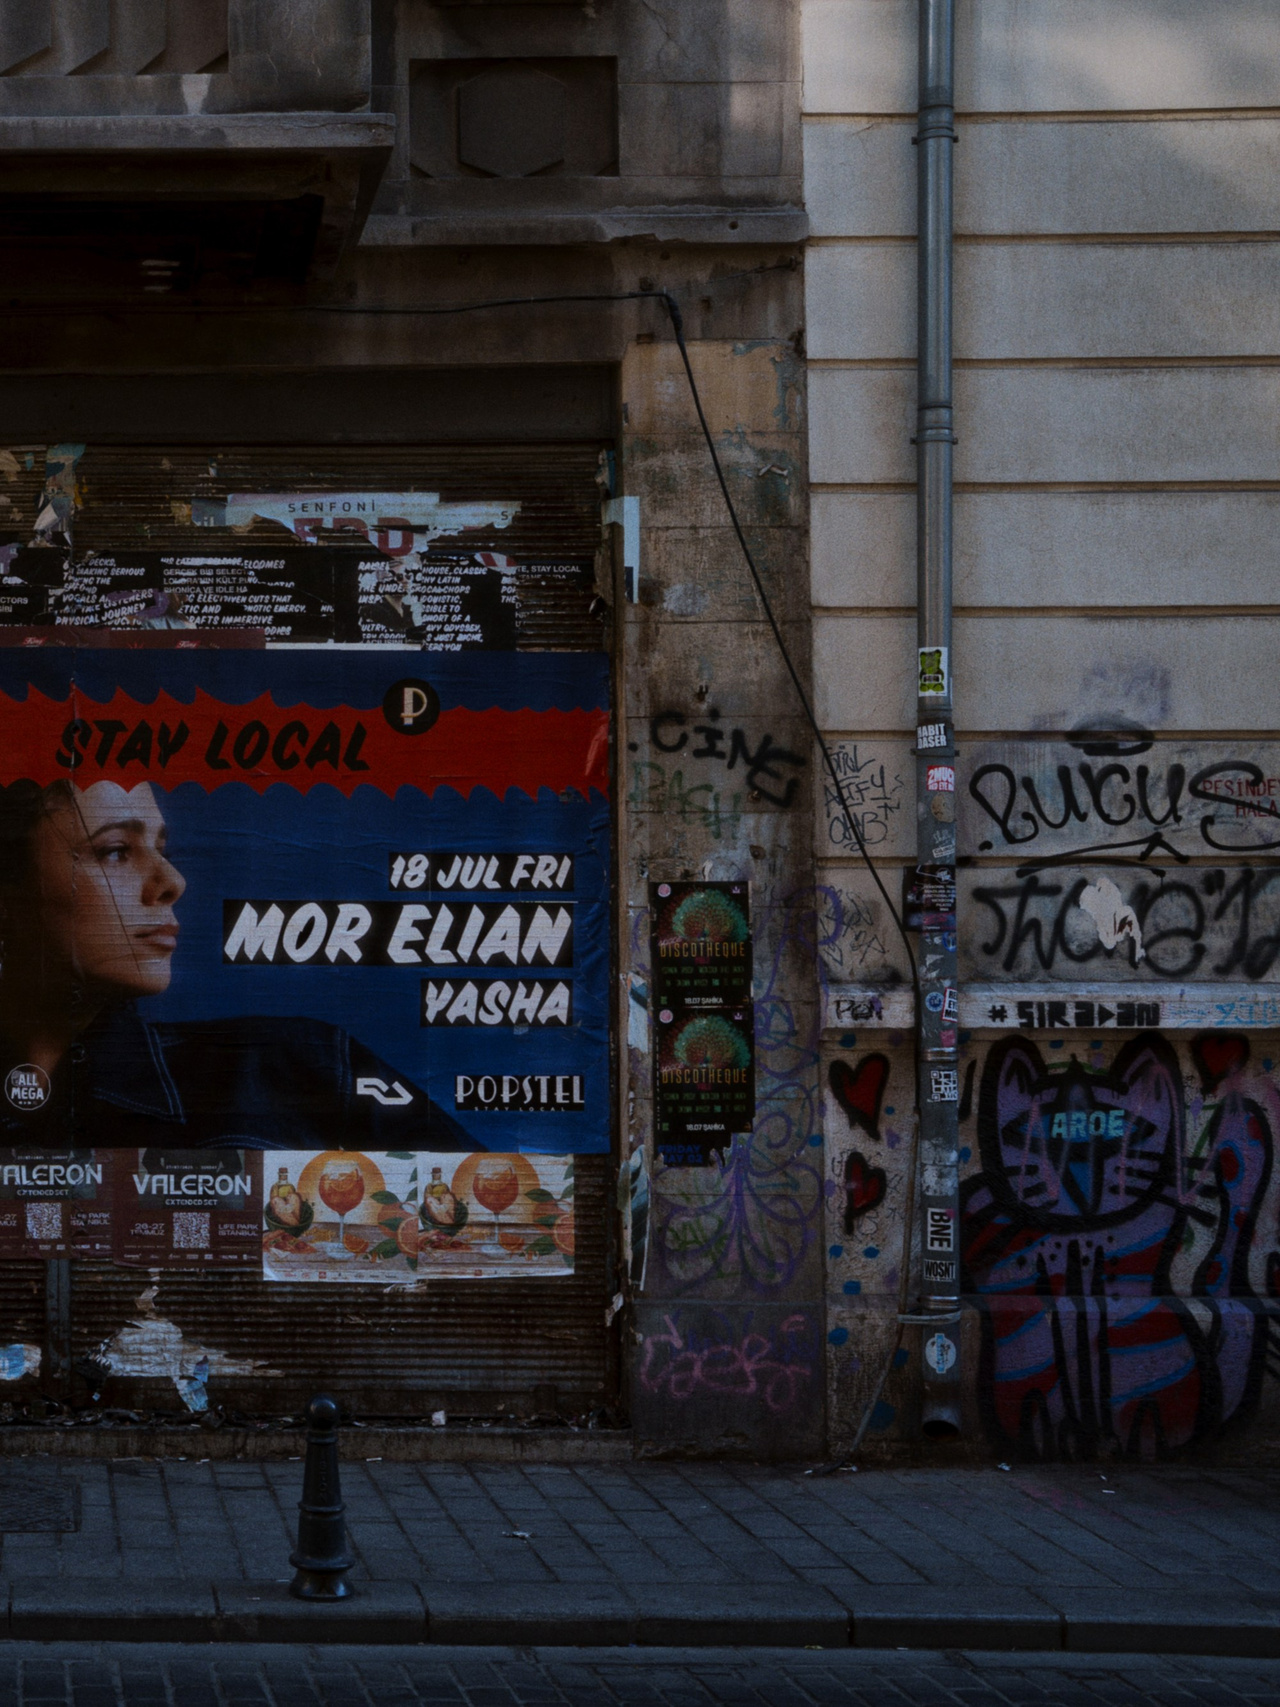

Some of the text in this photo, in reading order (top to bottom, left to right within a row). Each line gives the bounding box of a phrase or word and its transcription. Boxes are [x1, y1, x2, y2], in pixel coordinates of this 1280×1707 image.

[287, 499, 376, 513] SENFONİ
[110, 567, 146, 577] SERIOUS
[531, 565, 582, 575] STAY LOCAL
[54, 719, 371, 771] STAY LOCAL
[388, 853, 572, 890] 18 JUL FRI
[223, 901, 572, 965] MOR ELIAN
[659, 941, 746, 959] DISCOTHEQUE
[424, 980, 571, 1026] YASHA
[18, 1073, 39, 1086] ALL
[660, 1068, 747, 1085] DISCOTHEQUE
[10, 1087, 45, 1100] MEGA
[454, 1075, 585, 1104] POPSTEL
[1050, 1109, 1126, 1140] AROE
[657, 1144, 701, 1155] FRIDAY
[132, 1173, 252, 1196] VALERON
[930, 1209, 952, 1247] BNE
